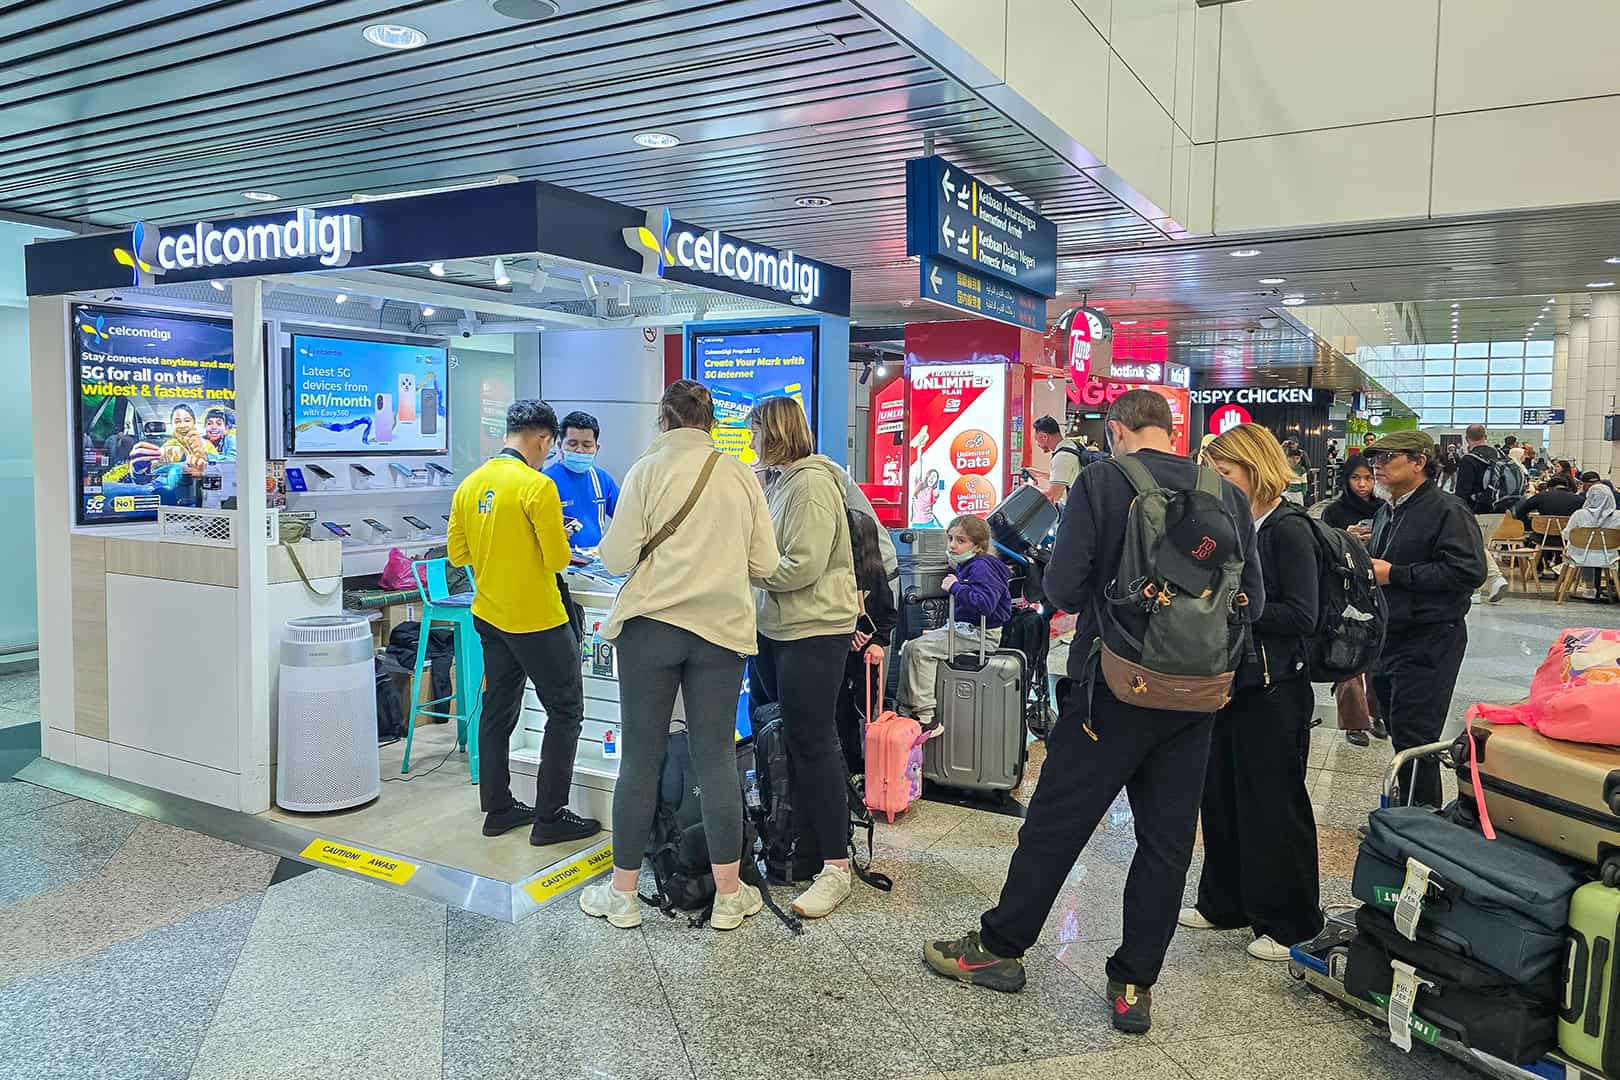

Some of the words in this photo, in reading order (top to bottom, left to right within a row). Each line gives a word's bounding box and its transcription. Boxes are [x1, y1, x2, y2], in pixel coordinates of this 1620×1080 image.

[158, 208, 353, 270] celcomdigi
[676, 230, 820, 304] celcomdigi
[108, 325, 172, 342] celcomdigi
[82, 351, 106, 363] Stay
[107, 353, 159, 365] connected
[160, 357, 198, 369] anytime
[199, 360, 217, 369] and
[704, 360, 734, 368] Create
[735, 358, 756, 367] Your
[757, 357, 782, 366] Mark
[782, 356, 805, 366] with
[82, 365, 105, 379] 5G
[107, 366, 130, 381] for
[132, 368, 152, 382] all
[154, 372, 174, 383] on
[176, 370, 202, 384] the
[302, 366, 334, 377] Latest
[336, 367, 351, 378] 5G
[718, 370, 754, 379] Internet
[1110, 364, 1145, 378] hotlink
[81, 381, 138, 396] widest
[140, 384, 152, 397] &
[154, 384, 204, 399] fastest
[302, 380, 342, 391] devices
[344, 382, 368, 393] from
[912, 375, 992, 390] UNLIMITED
[300, 393, 372, 408] RM1/month
[1236, 388, 1313, 403] CHICKEN
[303, 408, 320, 417] with
[956, 456, 990, 469] Data
[86, 498, 105, 510] 5G
[957, 499, 990, 511] Calls
[1192, 535, 1217, 560] B
[321, 845, 361, 861] CAUTION!
[367, 858, 398, 871] AWAS!
[541, 865, 581, 888] CAUTION!
